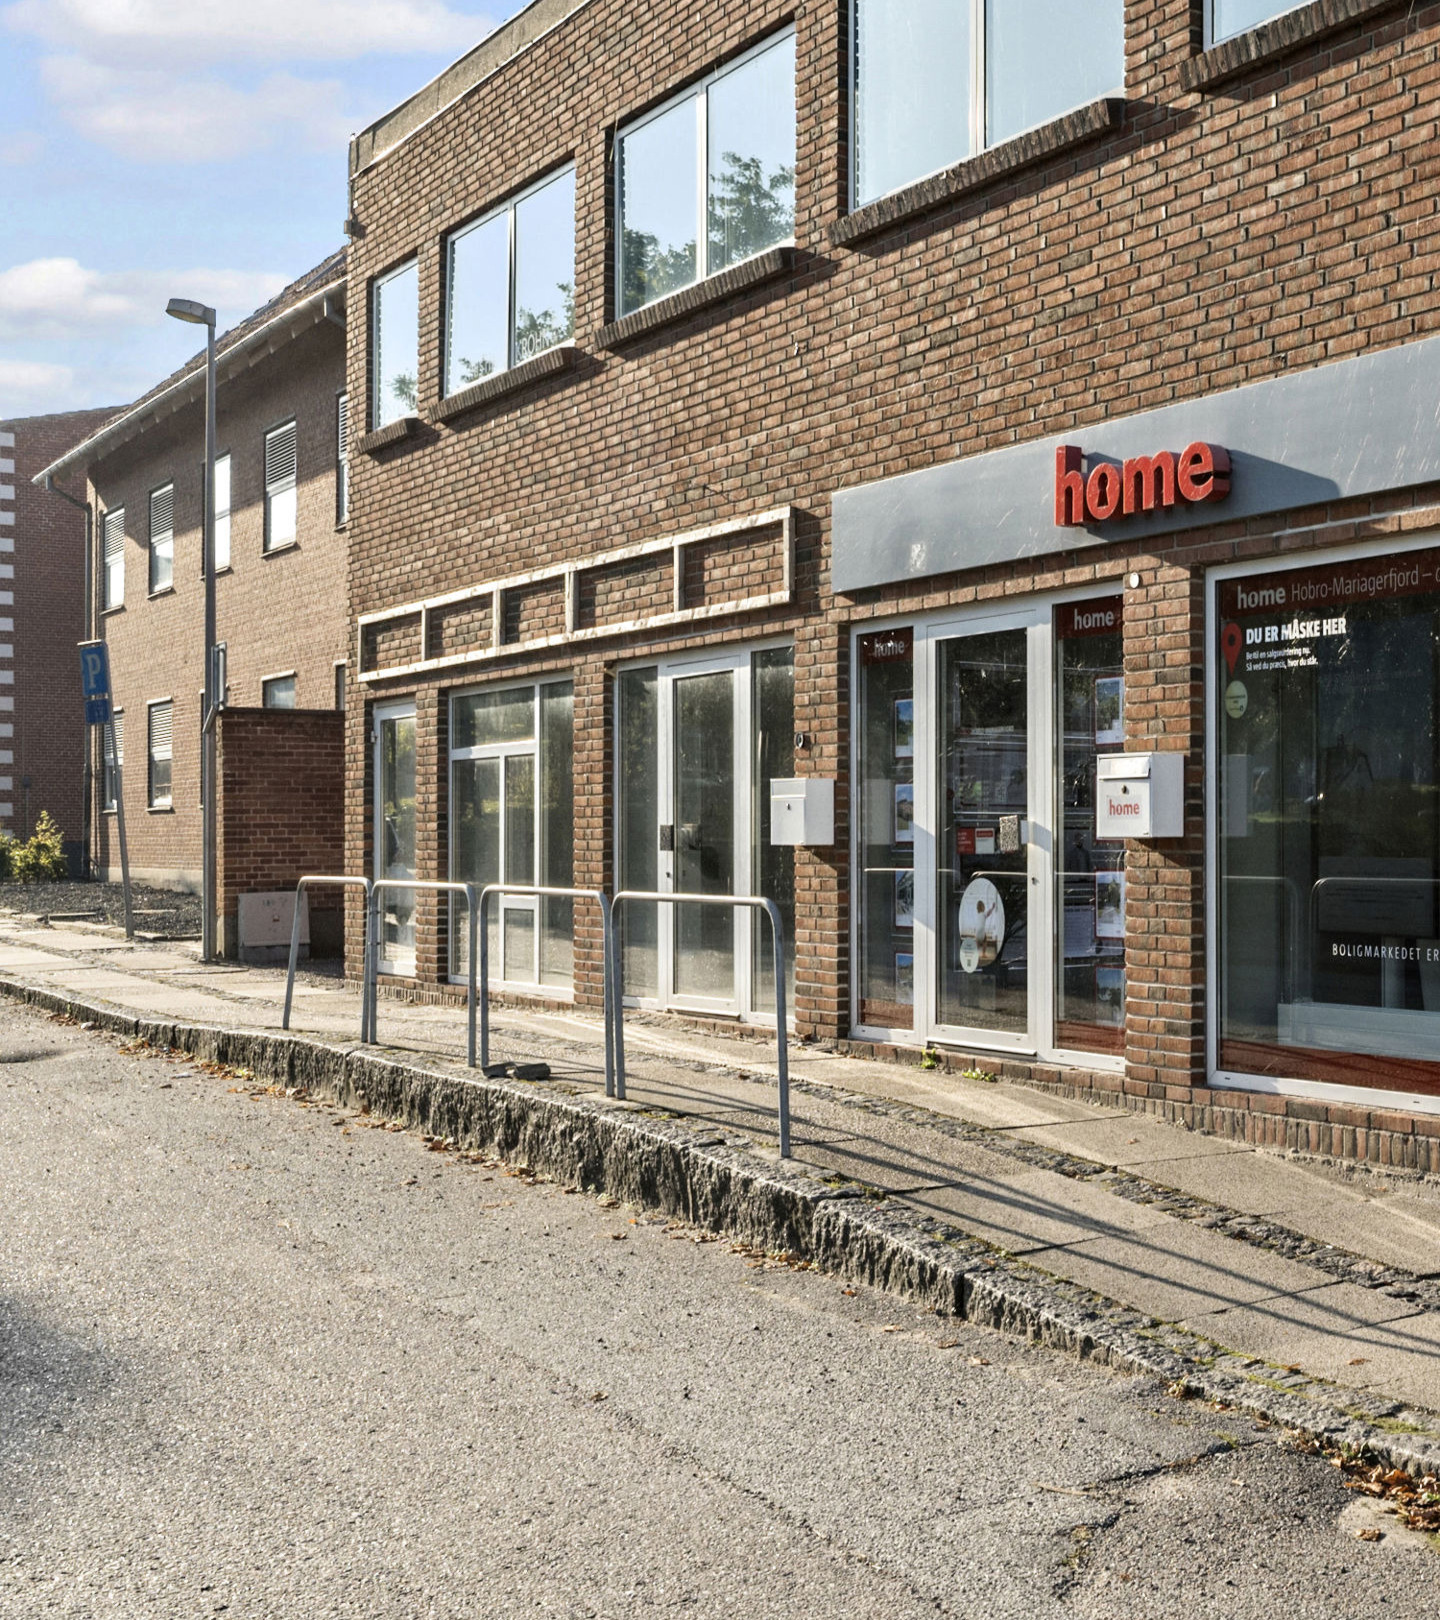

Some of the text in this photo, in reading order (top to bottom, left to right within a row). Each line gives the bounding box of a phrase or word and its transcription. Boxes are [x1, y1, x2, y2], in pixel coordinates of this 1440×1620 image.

[1055, 441, 1222, 527] home
[1237, 586, 1286, 609] home
[1291, 564, 1419, 602] Hobro-Mariagerfjord
[1073, 608, 1115, 631] home
[1246, 617, 1347, 645] DU ER MÅSKE HER
[873, 638, 905, 658] home
[86, 653, 102, 690] P
[1108, 798, 1141, 816] home
[1332, 943, 1421, 961] BOLIGMARKEDET
[1426, 948, 1440, 962] ER
